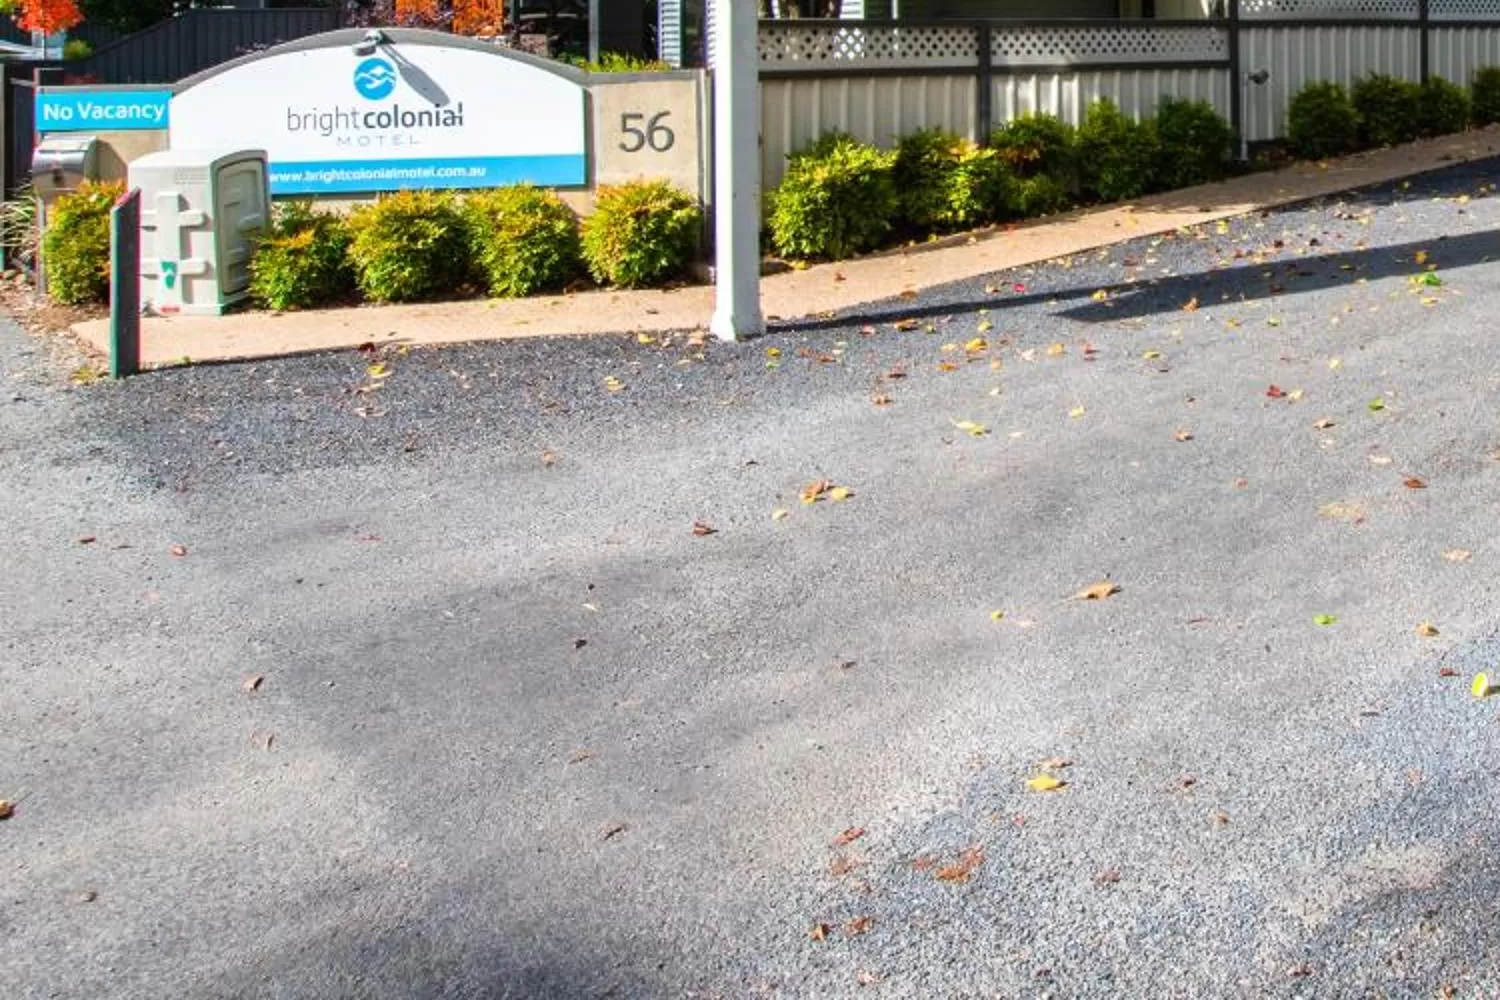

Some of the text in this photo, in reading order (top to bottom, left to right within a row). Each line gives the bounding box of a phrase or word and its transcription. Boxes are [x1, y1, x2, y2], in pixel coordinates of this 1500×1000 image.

[43, 102, 165, 124] No Vacancy
[336, 135, 421, 147] MOTEL
[619, 110, 675, 153] 56
